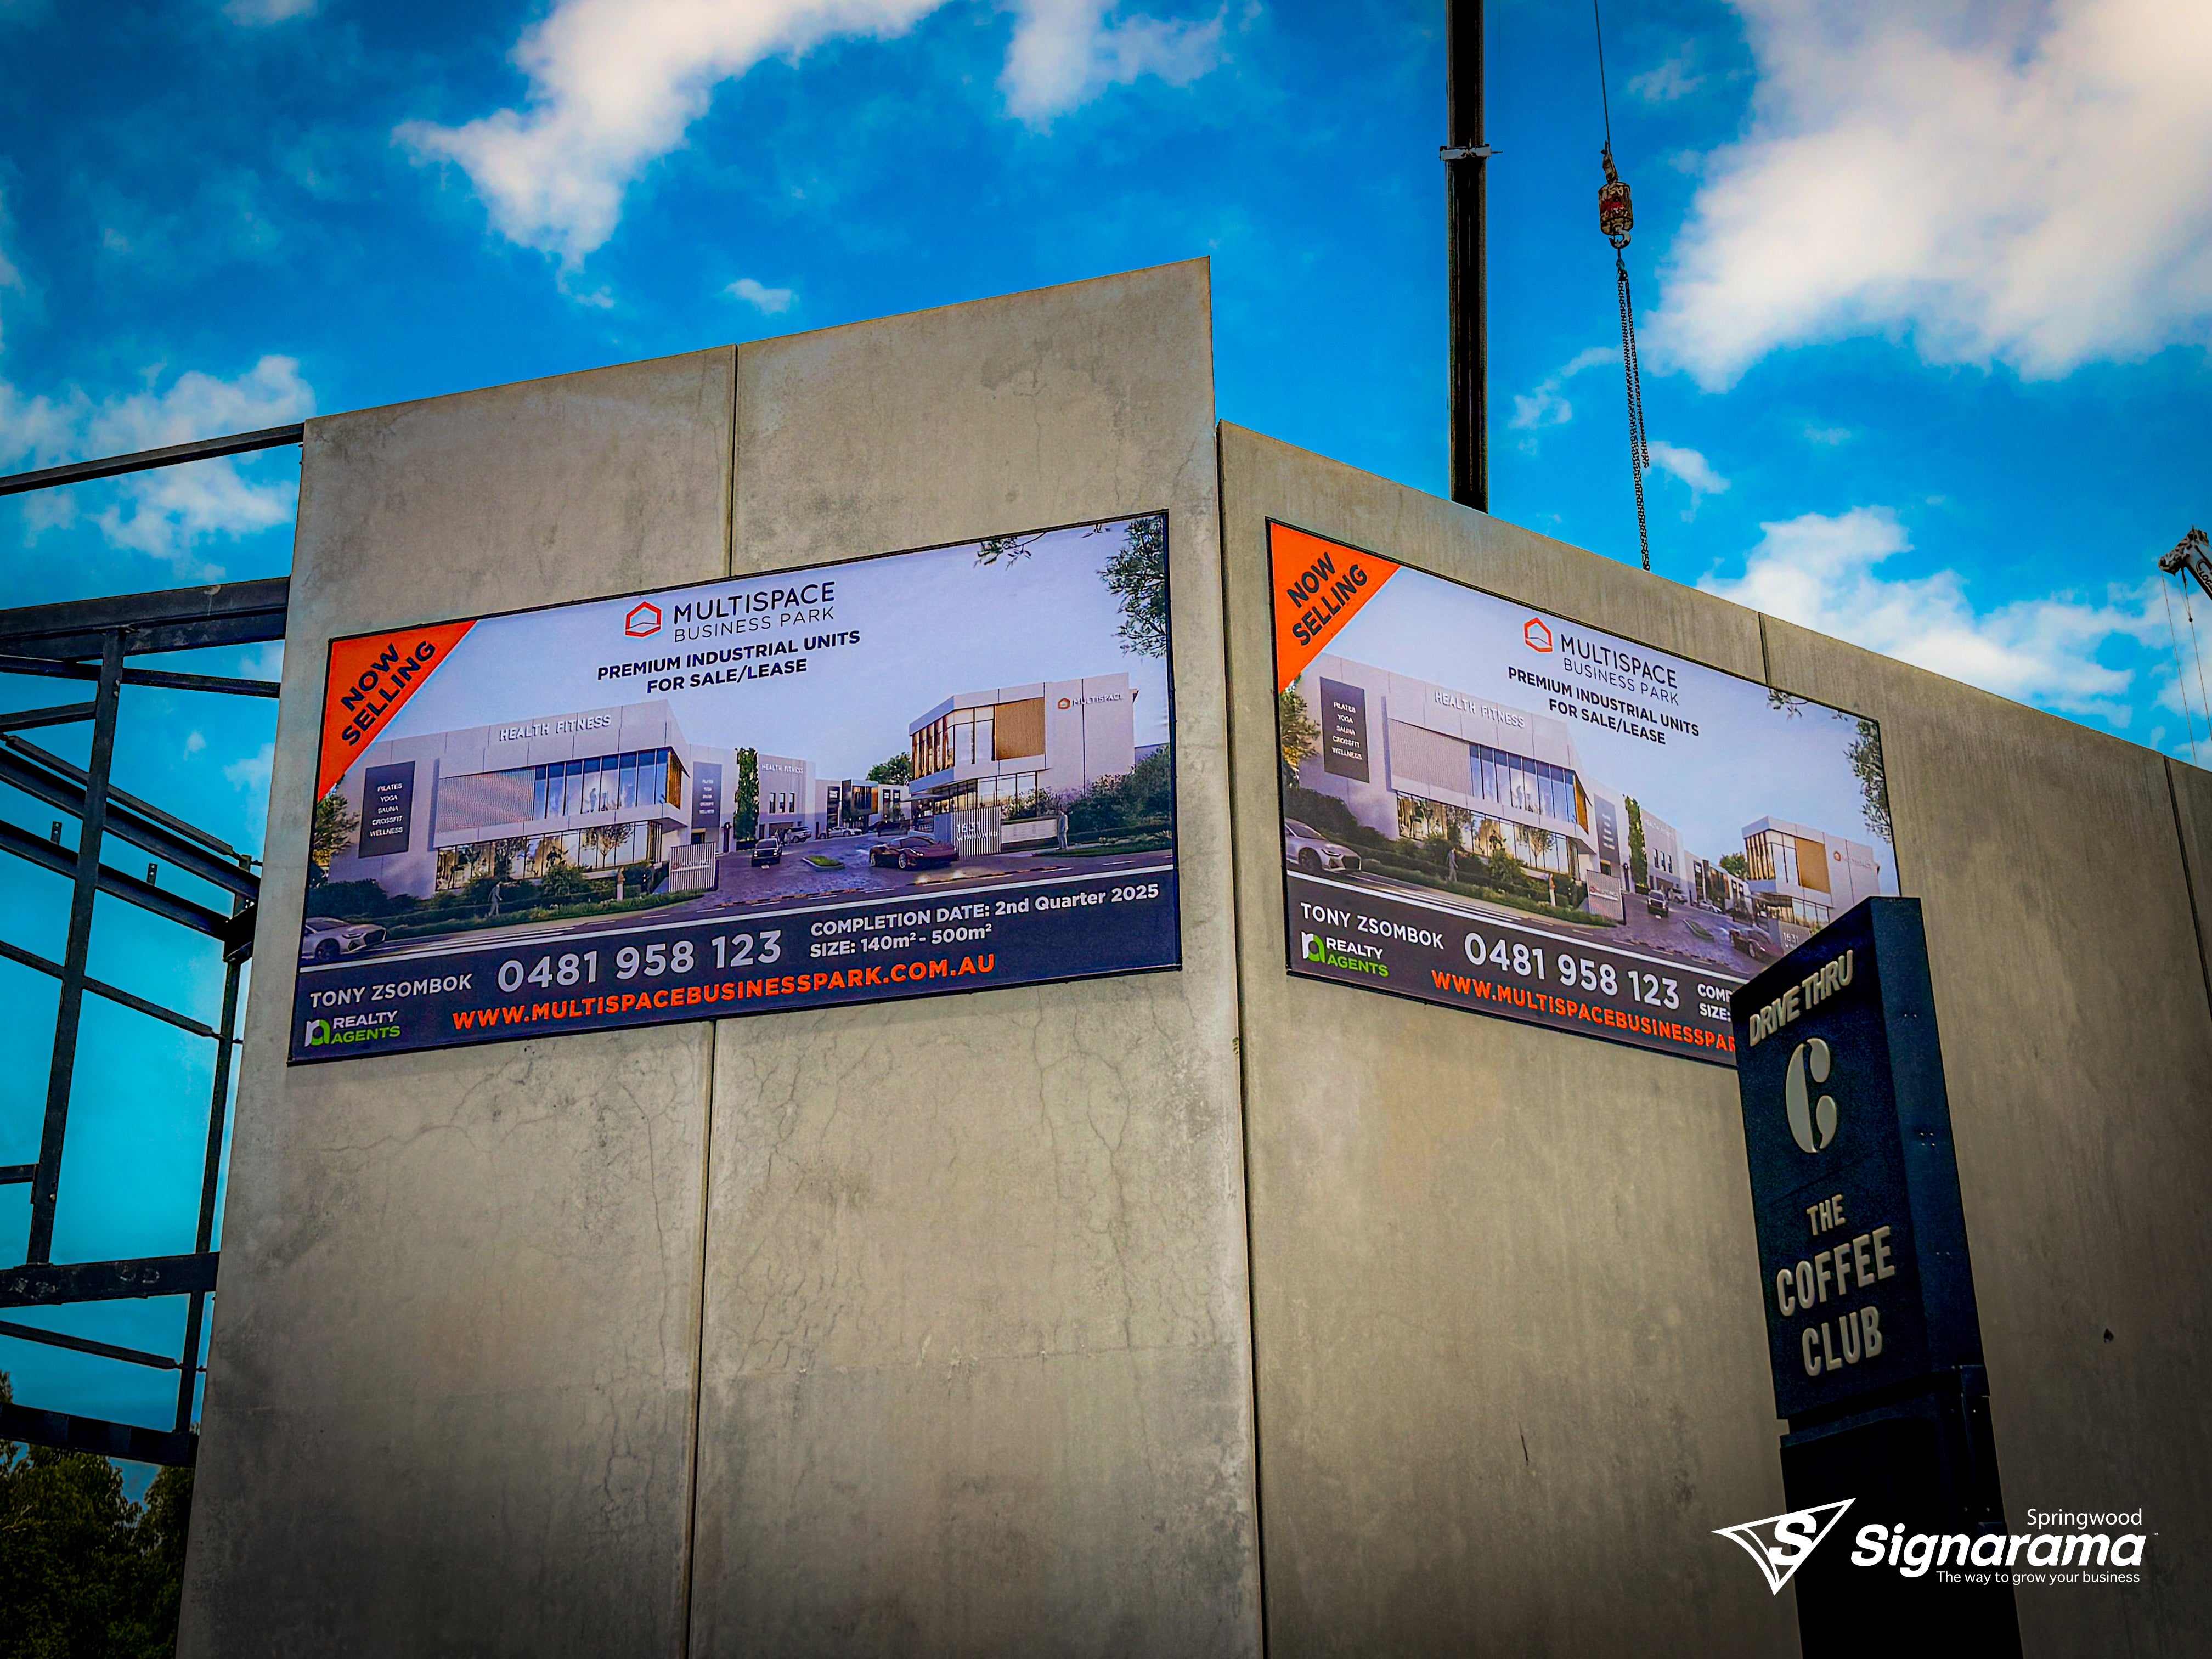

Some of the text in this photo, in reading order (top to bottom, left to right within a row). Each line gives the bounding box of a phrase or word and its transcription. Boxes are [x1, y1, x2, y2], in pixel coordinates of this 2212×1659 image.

[674, 582, 835, 624] MULTISPACE
[1287, 552, 1335, 608] NOW
[674, 606, 834, 642] BUSINESS PARK
[1293, 564, 1367, 646] SELLING
[340, 642, 399, 712] NOW
[597, 630, 860, 680] PREMIUM INDUSTRIAL UNITS
[647, 658, 807, 693] FOR SALE/LEASE
[1561, 634, 1677, 689] MULTISPACE
[341, 640, 436, 746] SELLING
[1508, 667, 1699, 736] PREMIUM INDUSTRIAL UNITS
[1564, 658, 1679, 706] BUSINESS PARK
[499, 714, 612, 742] HEALTH FITNESS
[1434, 690, 1526, 729] HEALTH FITNESS
[1549, 698, 1666, 745] FOR SALE/LEASE
[811, 884, 1159, 936] COMPLETION DATE: 2nd Quarter 2025
[1301, 902, 1444, 950] TONY ZSOMBOK
[498, 930, 782, 993] 0481 958 123
[810, 941, 856, 958] SIZE:
[932, 923, 992, 944] 500m²
[1325, 937, 1384, 960] REALTY
[311, 974, 473, 1008] TONY ZSOMBOK
[1327, 956, 1389, 978] AGENTS
[1464, 933, 1680, 1009] 0481 958 123
[452, 953, 996, 1030] WWW.MULTISPACEBUSINESSPARK.COM.AU
[1750, 950, 1853, 1047] DRIVE THRU
[331, 1026, 400, 1044] AGENTS
[333, 1011, 398, 1029] REALTY
[1807, 1194, 1846, 1236] THE
[1776, 1226, 1895, 1317] COFFEE
[1802, 1306, 1882, 1377] CLUB
